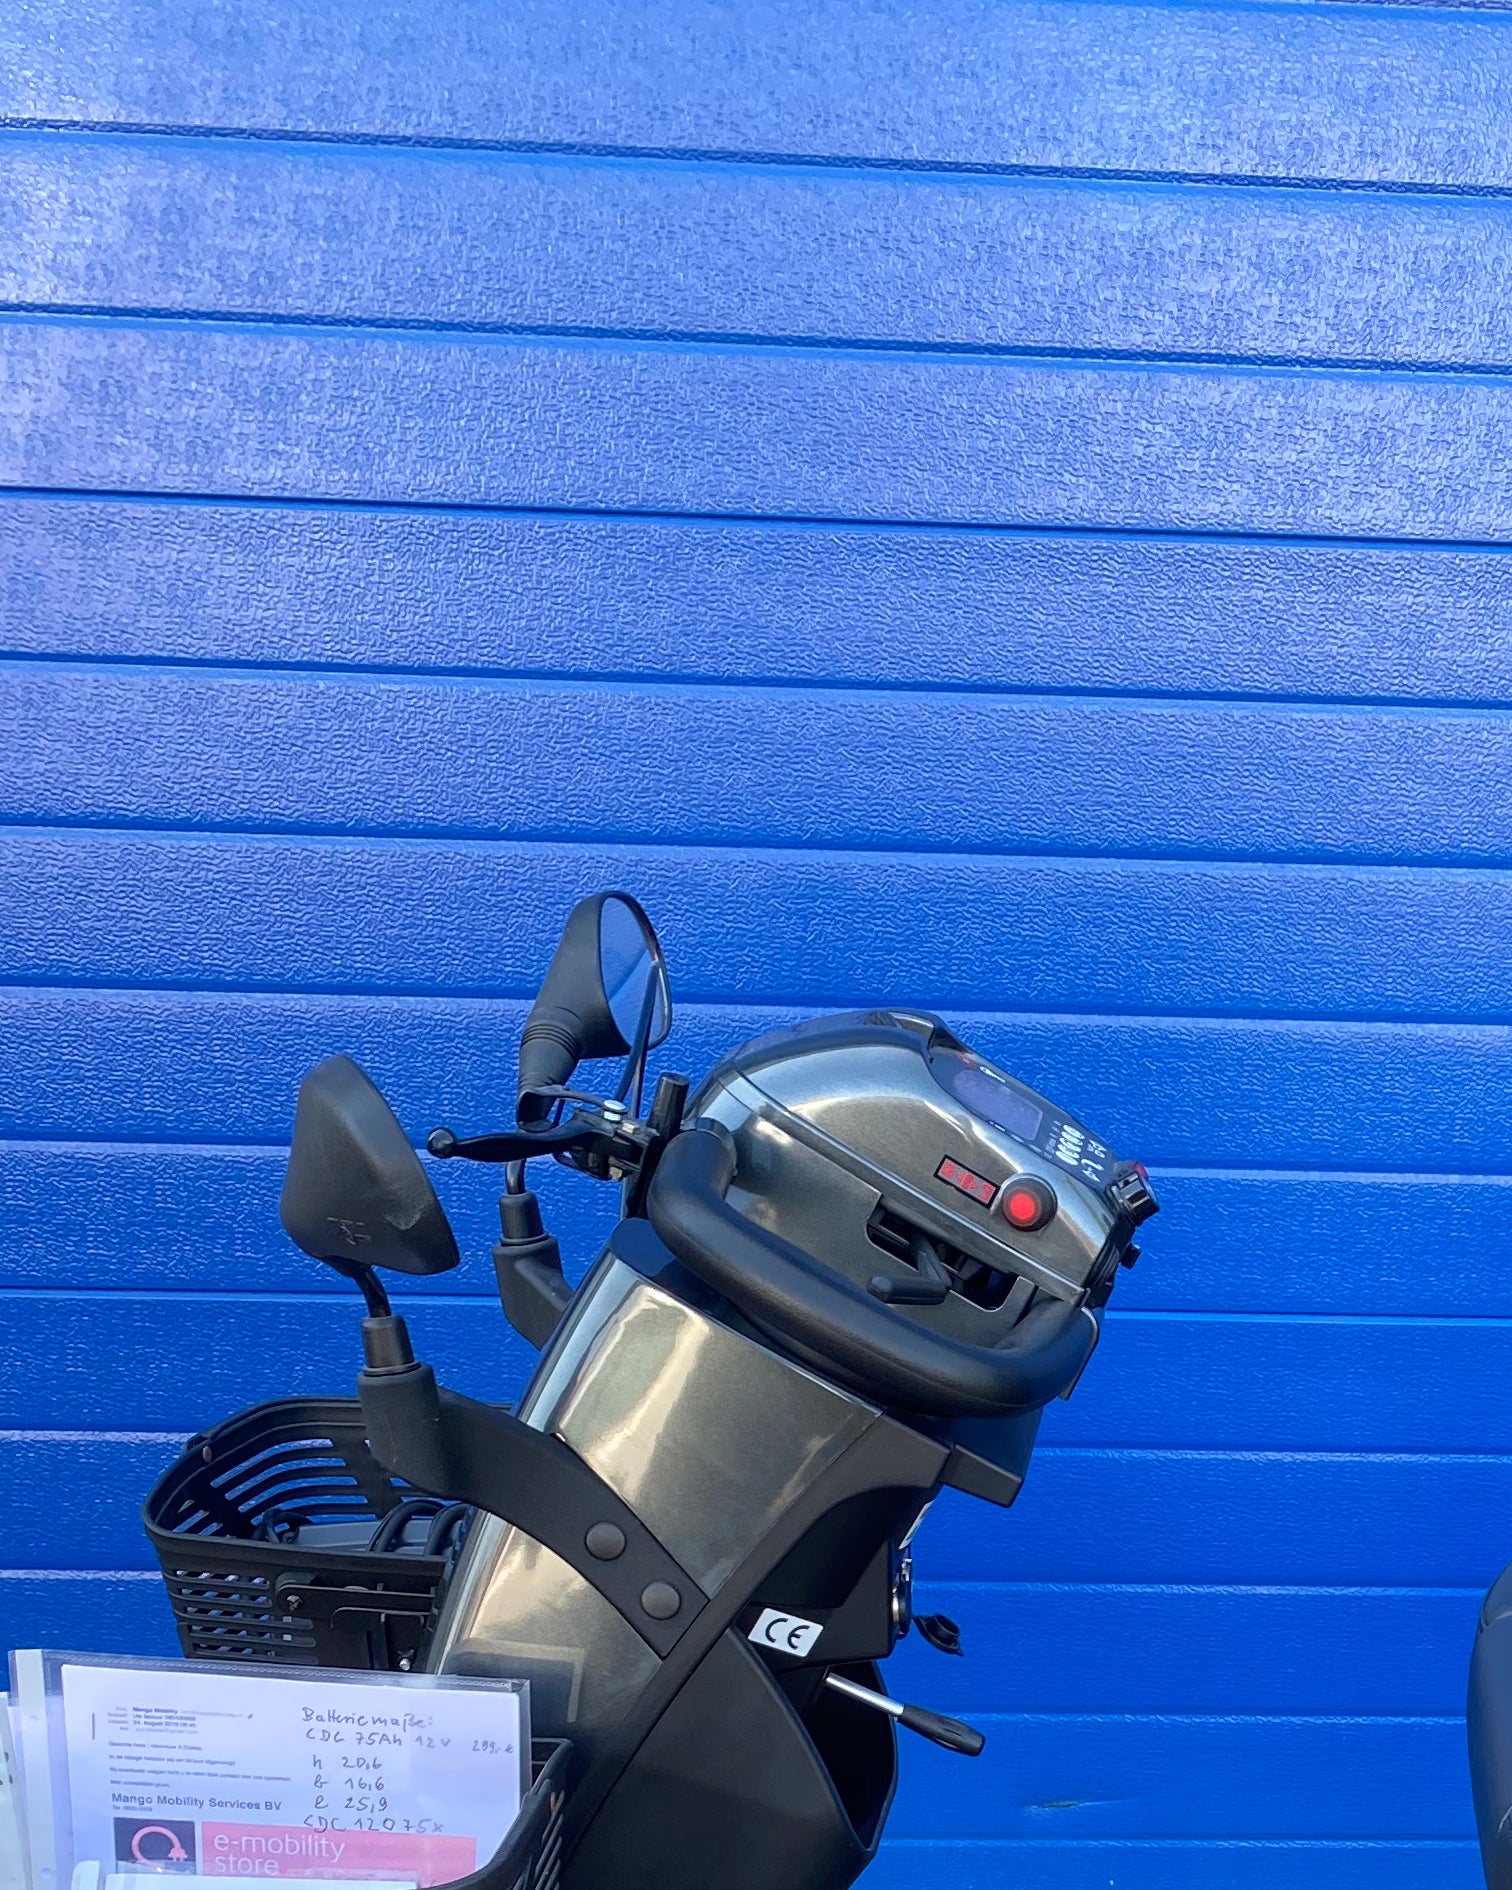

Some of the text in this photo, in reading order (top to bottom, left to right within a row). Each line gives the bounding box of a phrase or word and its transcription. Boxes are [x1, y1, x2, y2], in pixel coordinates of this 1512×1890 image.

[765, 1617, 810, 1650] CE
[306, 1728, 344, 1742] CDC
[356, 1732, 401, 1745] 75Ah
[341, 1756, 382, 1770] 20,6
[345, 1777, 384, 1791] 16,6
[112, 1793, 153, 1805] Mango
[157, 1795, 204, 1808] Mobility
[208, 1797, 261, 1810] Services
[265, 1801, 282, 1810] BV
[345, 1797, 387, 1813] 25,9
[303, 1814, 347, 1833] CDC
[214, 1833, 345, 1876] e-mobility store
